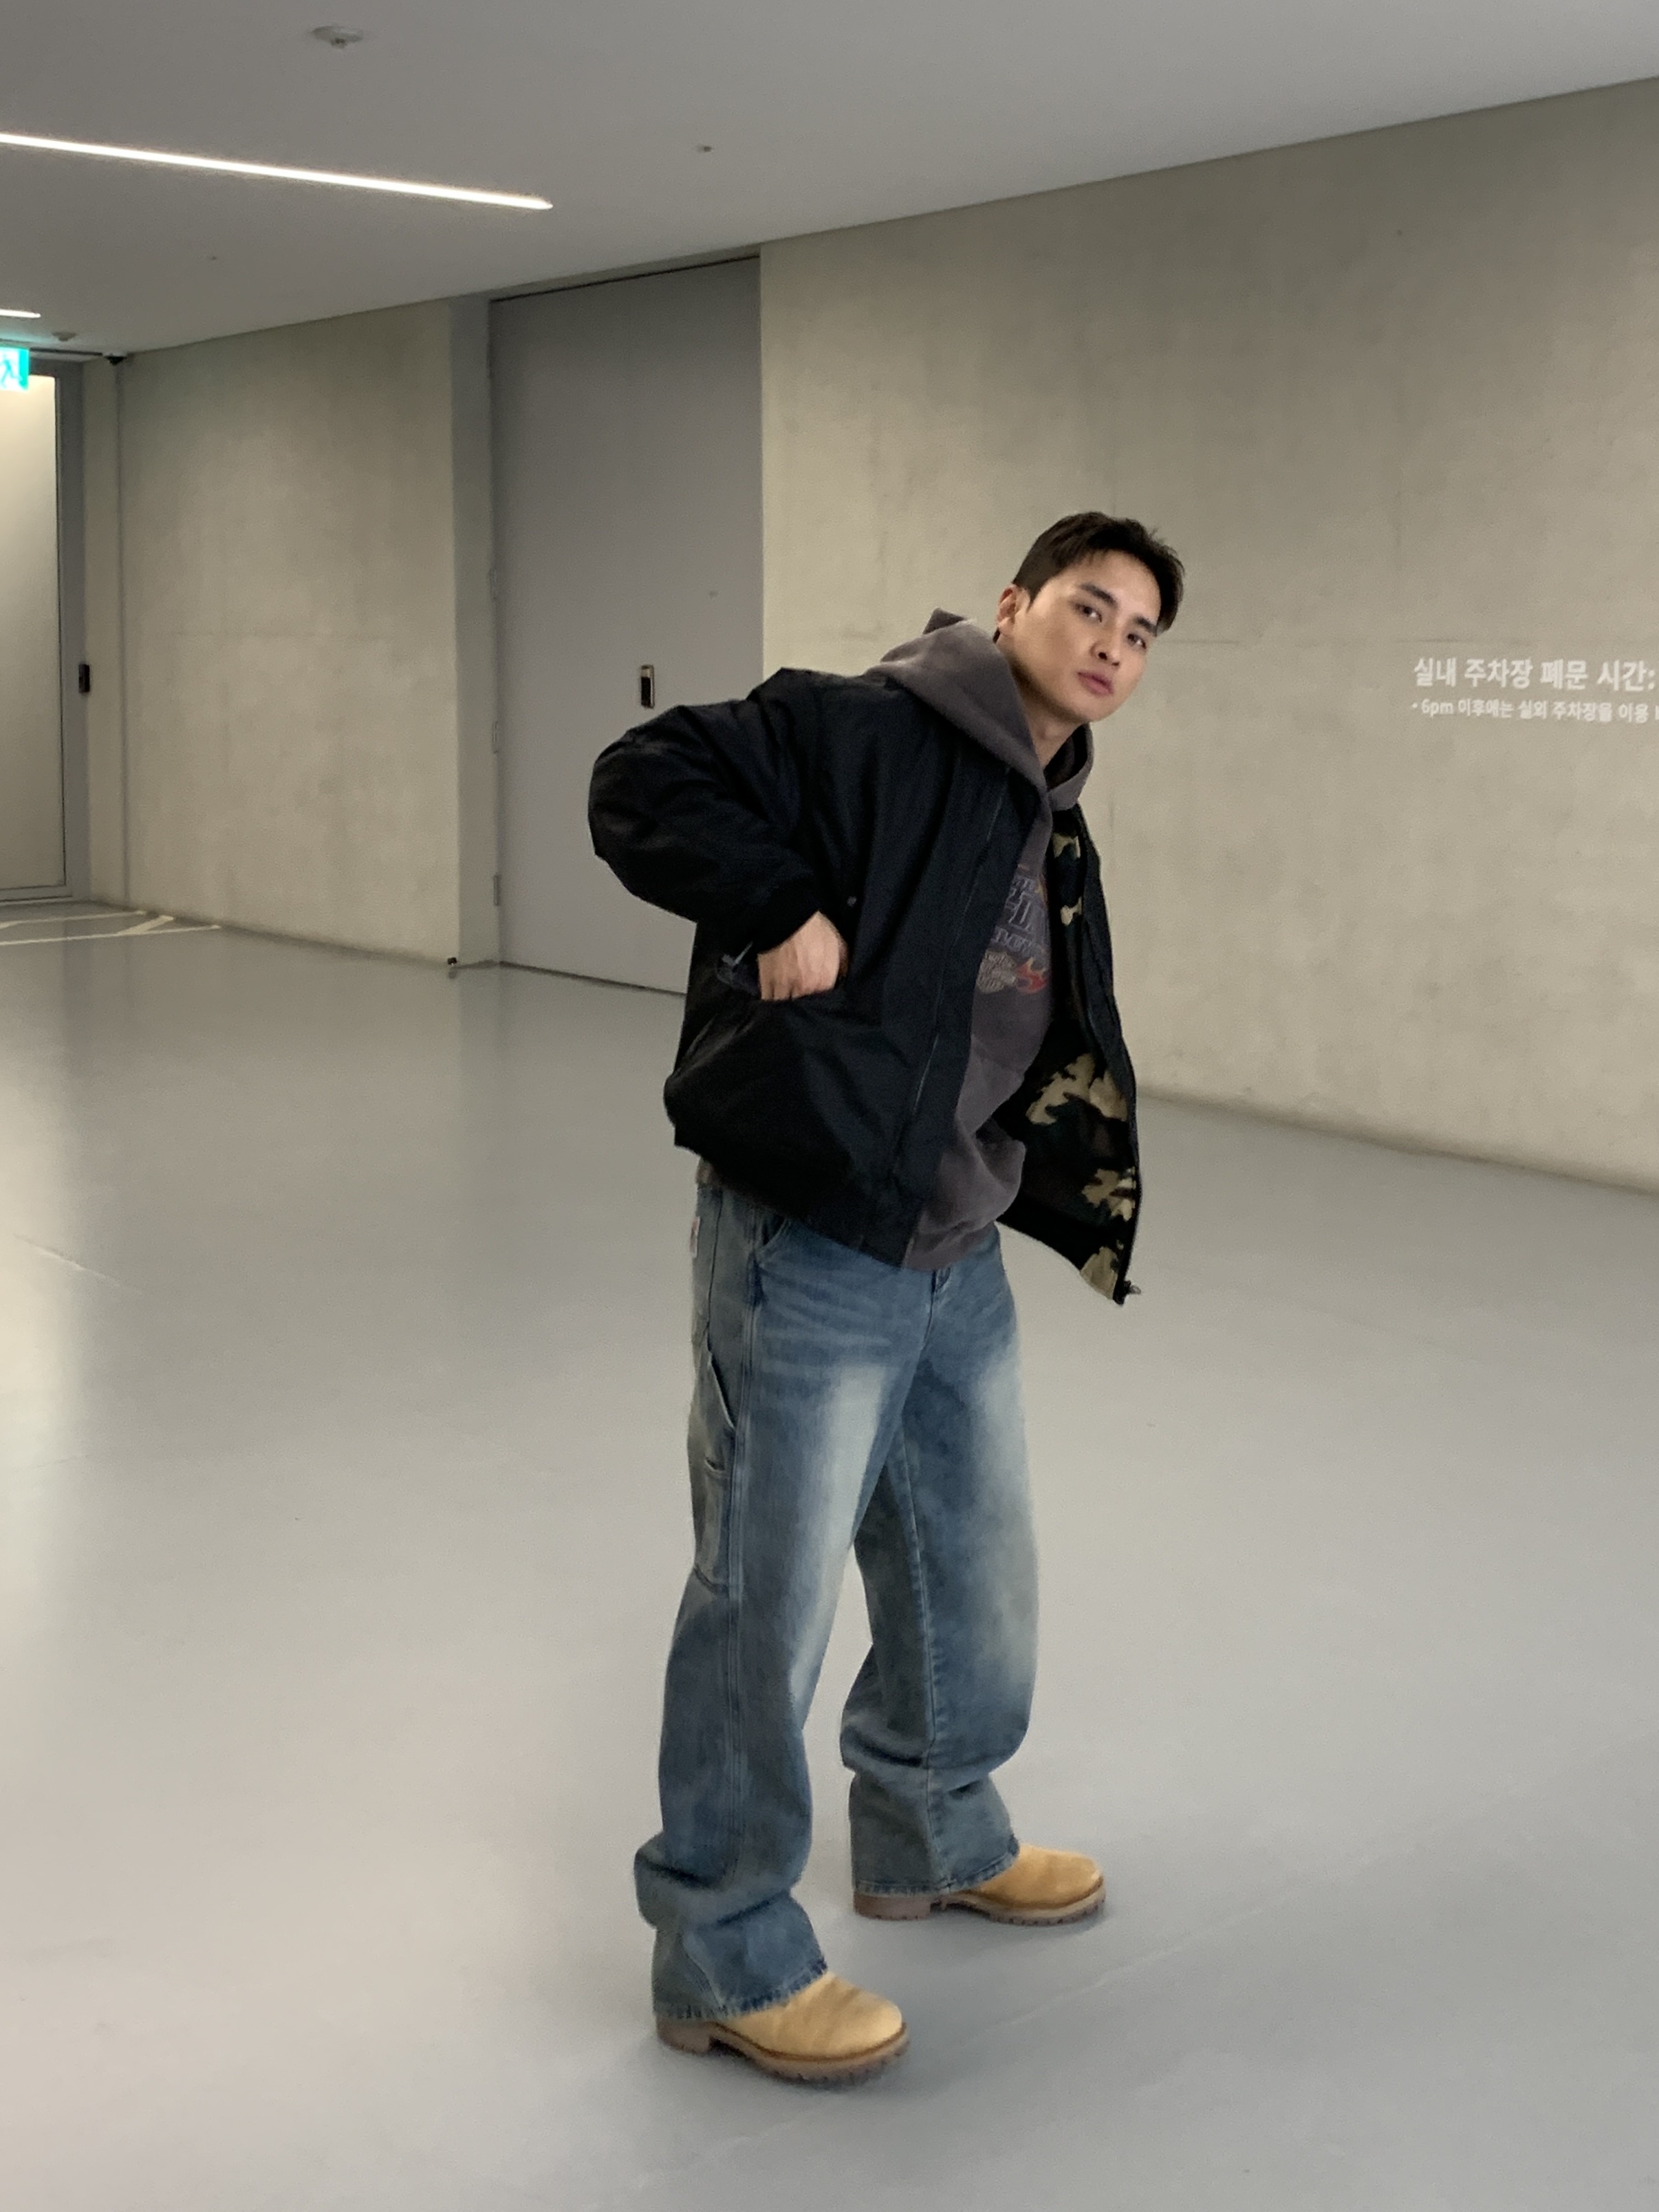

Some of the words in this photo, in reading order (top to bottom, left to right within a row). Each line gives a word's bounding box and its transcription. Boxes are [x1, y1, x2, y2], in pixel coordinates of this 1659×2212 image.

[1414, 658, 1457, 687] 실내
[1464, 657, 1534, 688] 주차장
[1540, 658, 1588, 690] 폐문
[1596, 659, 1655, 691] 시간:
[1421, 698, 1454, 717] 6pm
[1458, 698, 1514, 718] 이후에는
[1518, 700, 1547, 719] 실외
[1552, 700, 1612, 722] 주차장을
[1618, 702, 1649, 723] 이용
